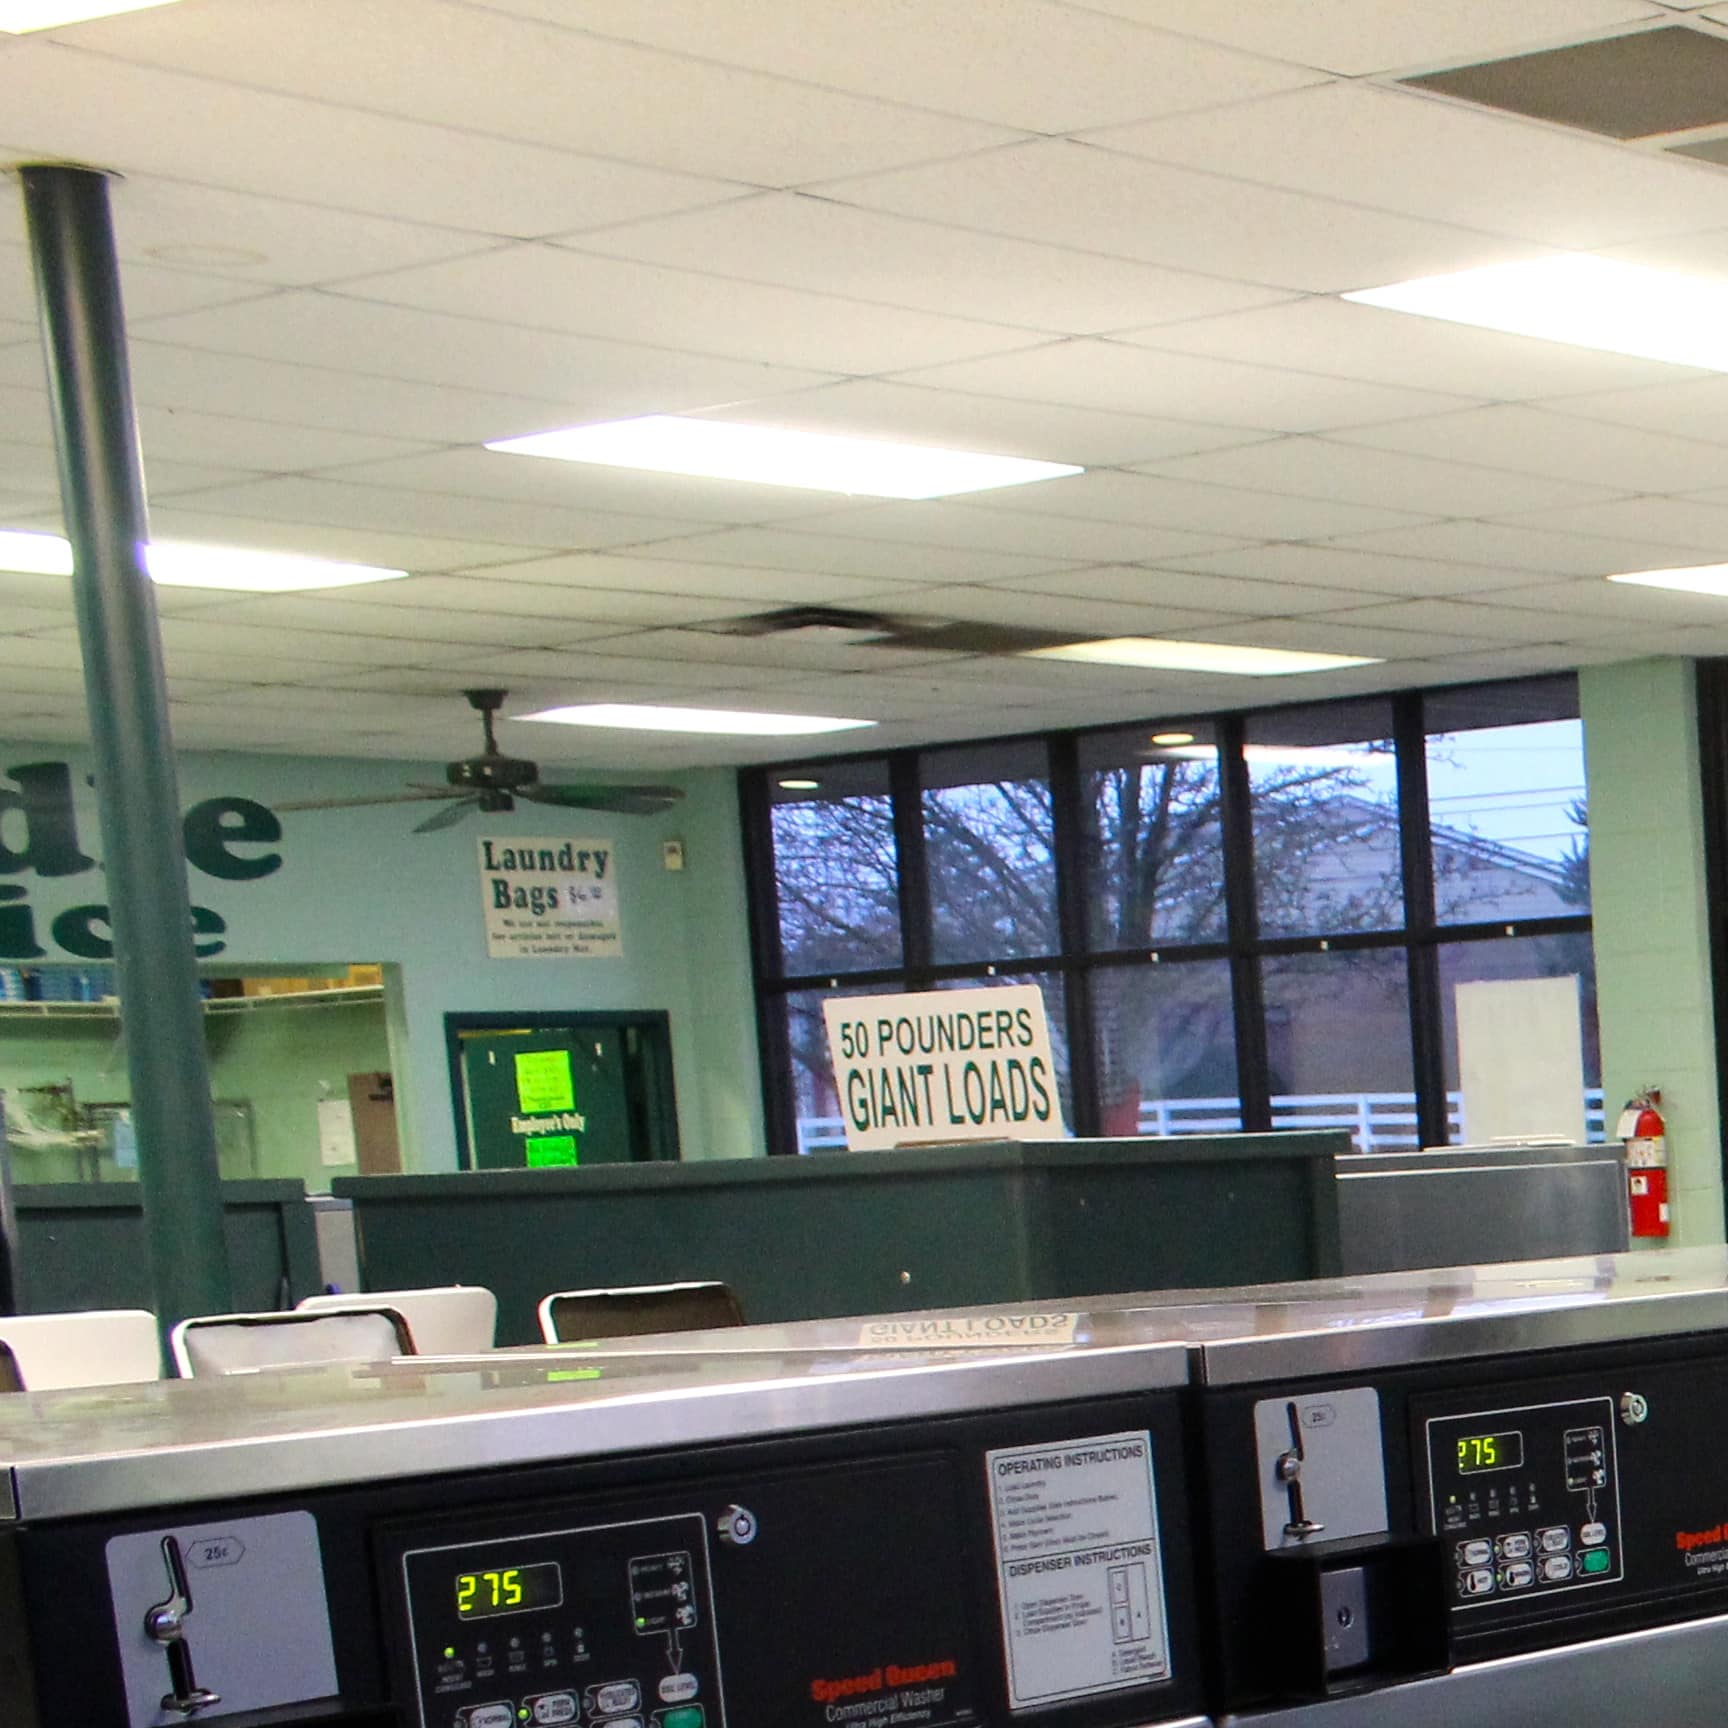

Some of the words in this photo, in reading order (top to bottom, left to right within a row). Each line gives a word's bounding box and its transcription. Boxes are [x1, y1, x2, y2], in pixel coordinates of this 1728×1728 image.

[482, 840, 608, 879] Laundry
[492, 878, 559, 916] Bags
[840, 1020, 869, 1060] 50
[878, 1008, 1034, 1058] POUNDERS
[846, 1064, 935, 1132] GIANT
[944, 1057, 1051, 1124] LOADS
[998, 1456, 1062, 1476] OPERATING
[1064, 1445, 1144, 1466] INSTRUCTIONS
[1676, 1525, 1721, 1551] Speed
[1009, 1556, 1071, 1577] DISPENSER
[1074, 1543, 1151, 1566] INSTRUCTIONS
[458, 1569, 522, 1612] 275
[811, 1668, 882, 1703] Speed
[885, 1659, 957, 1687] Queen
[826, 1692, 899, 1723] Commercial
[901, 1687, 945, 1708] Washer
